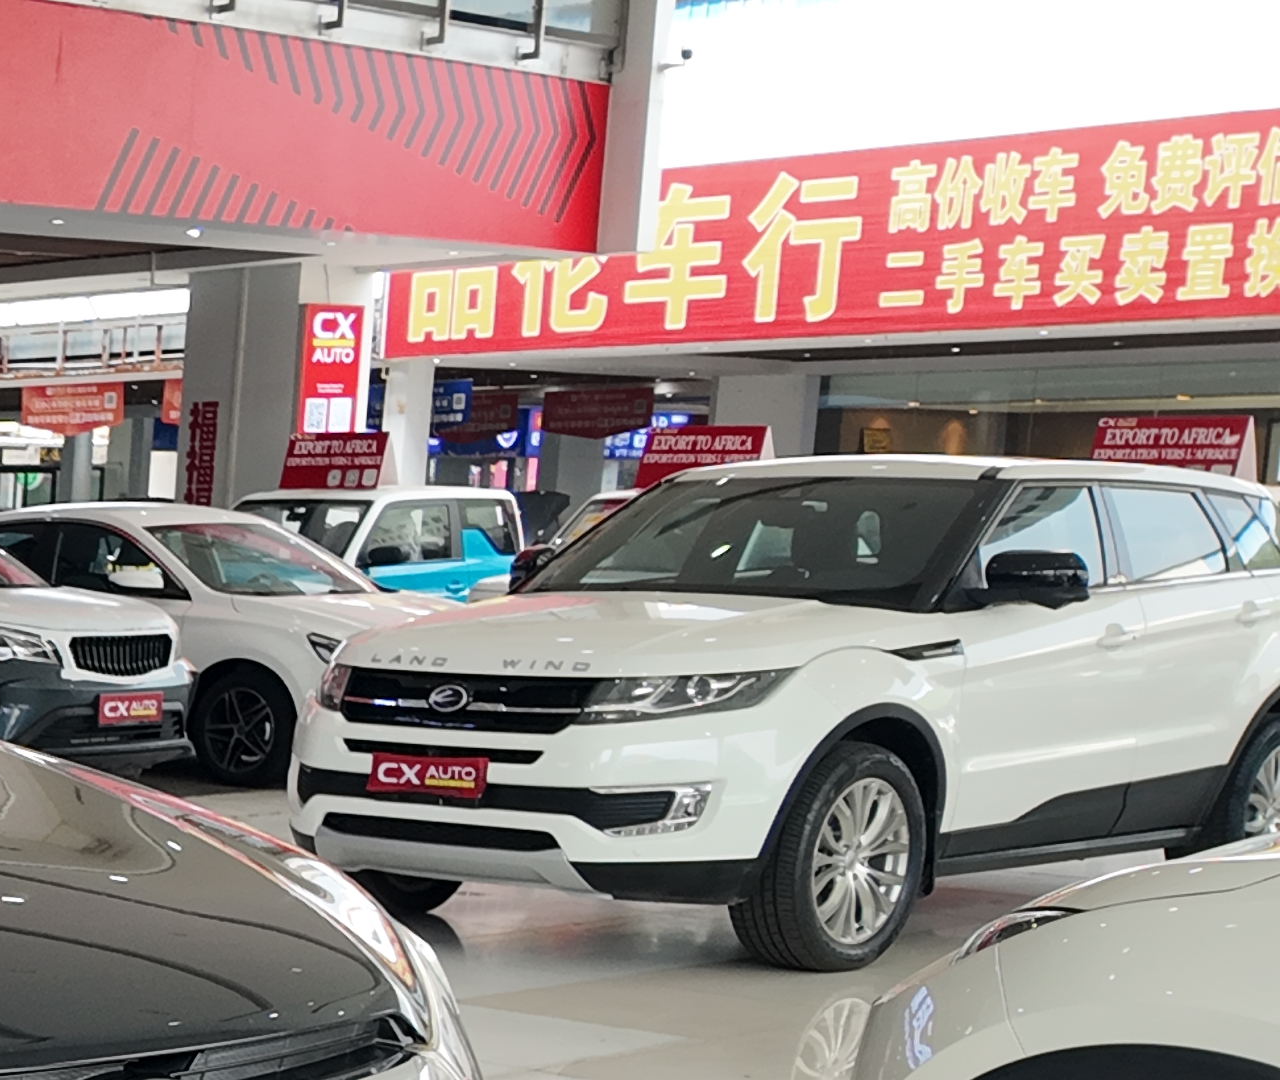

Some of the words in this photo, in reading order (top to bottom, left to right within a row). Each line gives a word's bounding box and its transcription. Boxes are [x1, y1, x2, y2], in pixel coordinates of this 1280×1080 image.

[887, 146, 1081, 234] 高价收车
[878, 218, 1280, 315] 二手车买卖置换
[312, 311, 357, 338] CX
[311, 347, 355, 364] AUTO
[652, 435, 696, 451] EXPORT
[696, 435, 713, 450] TO
[712, 435, 753, 451] AFRICA
[1103, 428, 1158, 446] EXPORT
[1159, 429, 1180, 445] TO
[1181, 427, 1232, 446] AFRICA
[370, 653, 448, 668] LAND
[502, 659, 591, 673] WIND
[103, 700, 130, 718] CX
[377, 762, 421, 785] CX
[425, 765, 476, 781] AUTO
